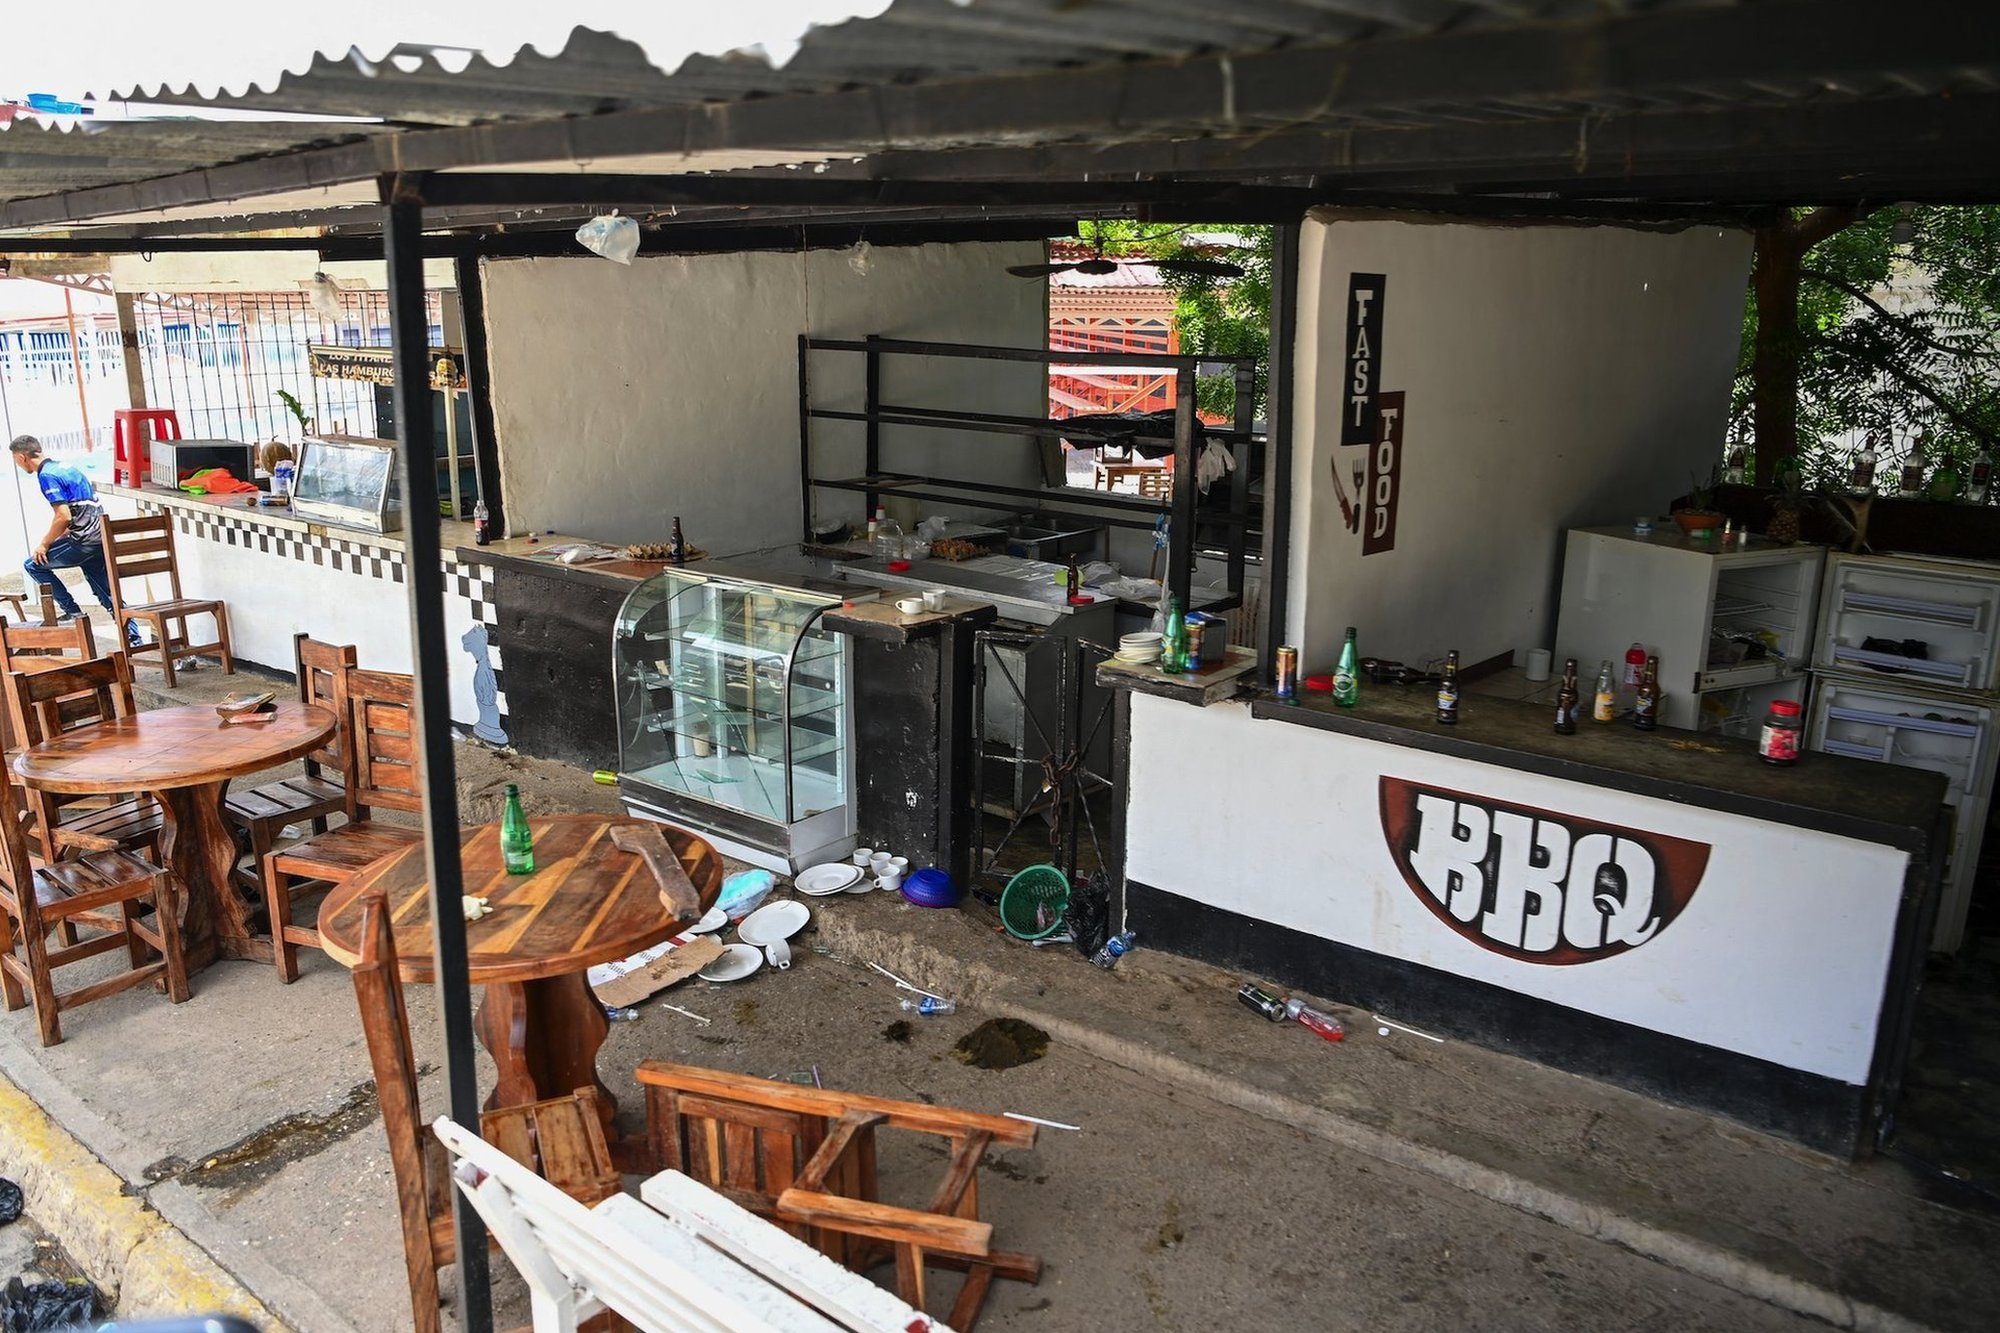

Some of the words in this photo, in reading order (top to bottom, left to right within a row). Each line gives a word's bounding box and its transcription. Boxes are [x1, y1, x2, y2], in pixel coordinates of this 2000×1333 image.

[320, 363, 339, 374] LAS
[1352, 289, 1374, 427] FAST
[1372, 408, 1398, 539] FOOD
[1409, 793, 1661, 952] BBQ
